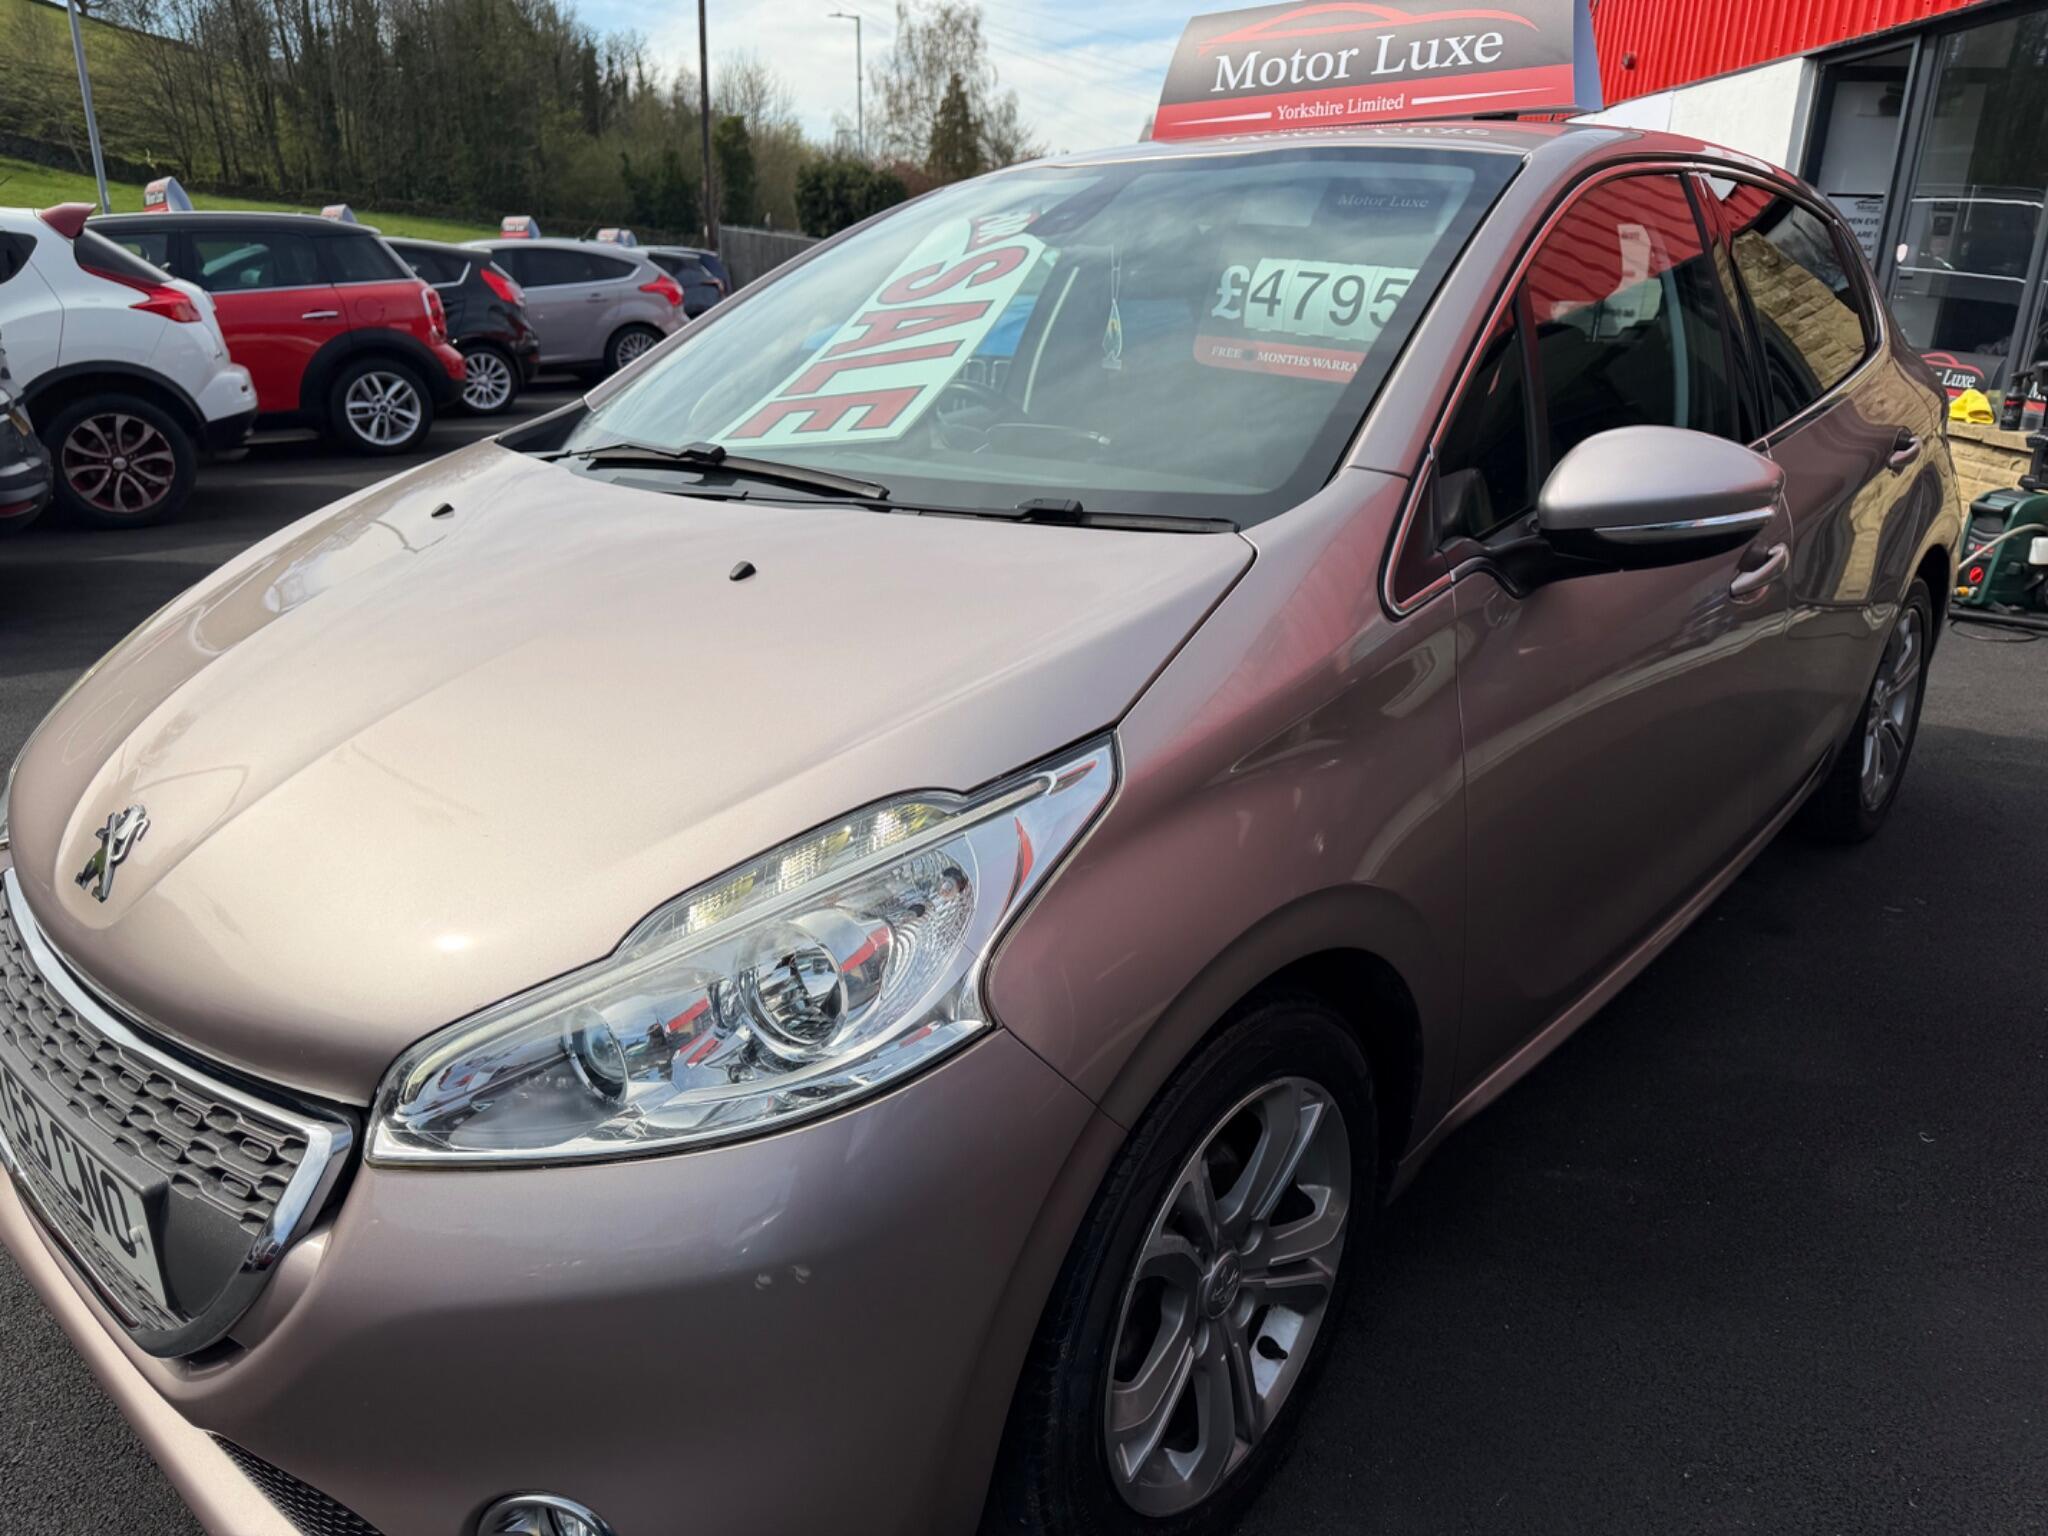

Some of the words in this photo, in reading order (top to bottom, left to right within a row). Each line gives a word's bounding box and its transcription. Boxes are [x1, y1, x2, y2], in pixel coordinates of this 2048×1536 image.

[1210, 47, 1358, 93] Motor
[1370, 31, 1504, 77] Luxe
[1276, 101, 1343, 121] Yorkshire
[1347, 94, 1404, 115] Limited
[1211, 265, 1411, 328] £4795
[722, 246, 1029, 440] SALE
[1211, 345, 1241, 359] FREE
[1257, 351, 1310, 367] MONTHS
[1942, 368, 1976, 388] Luxe
